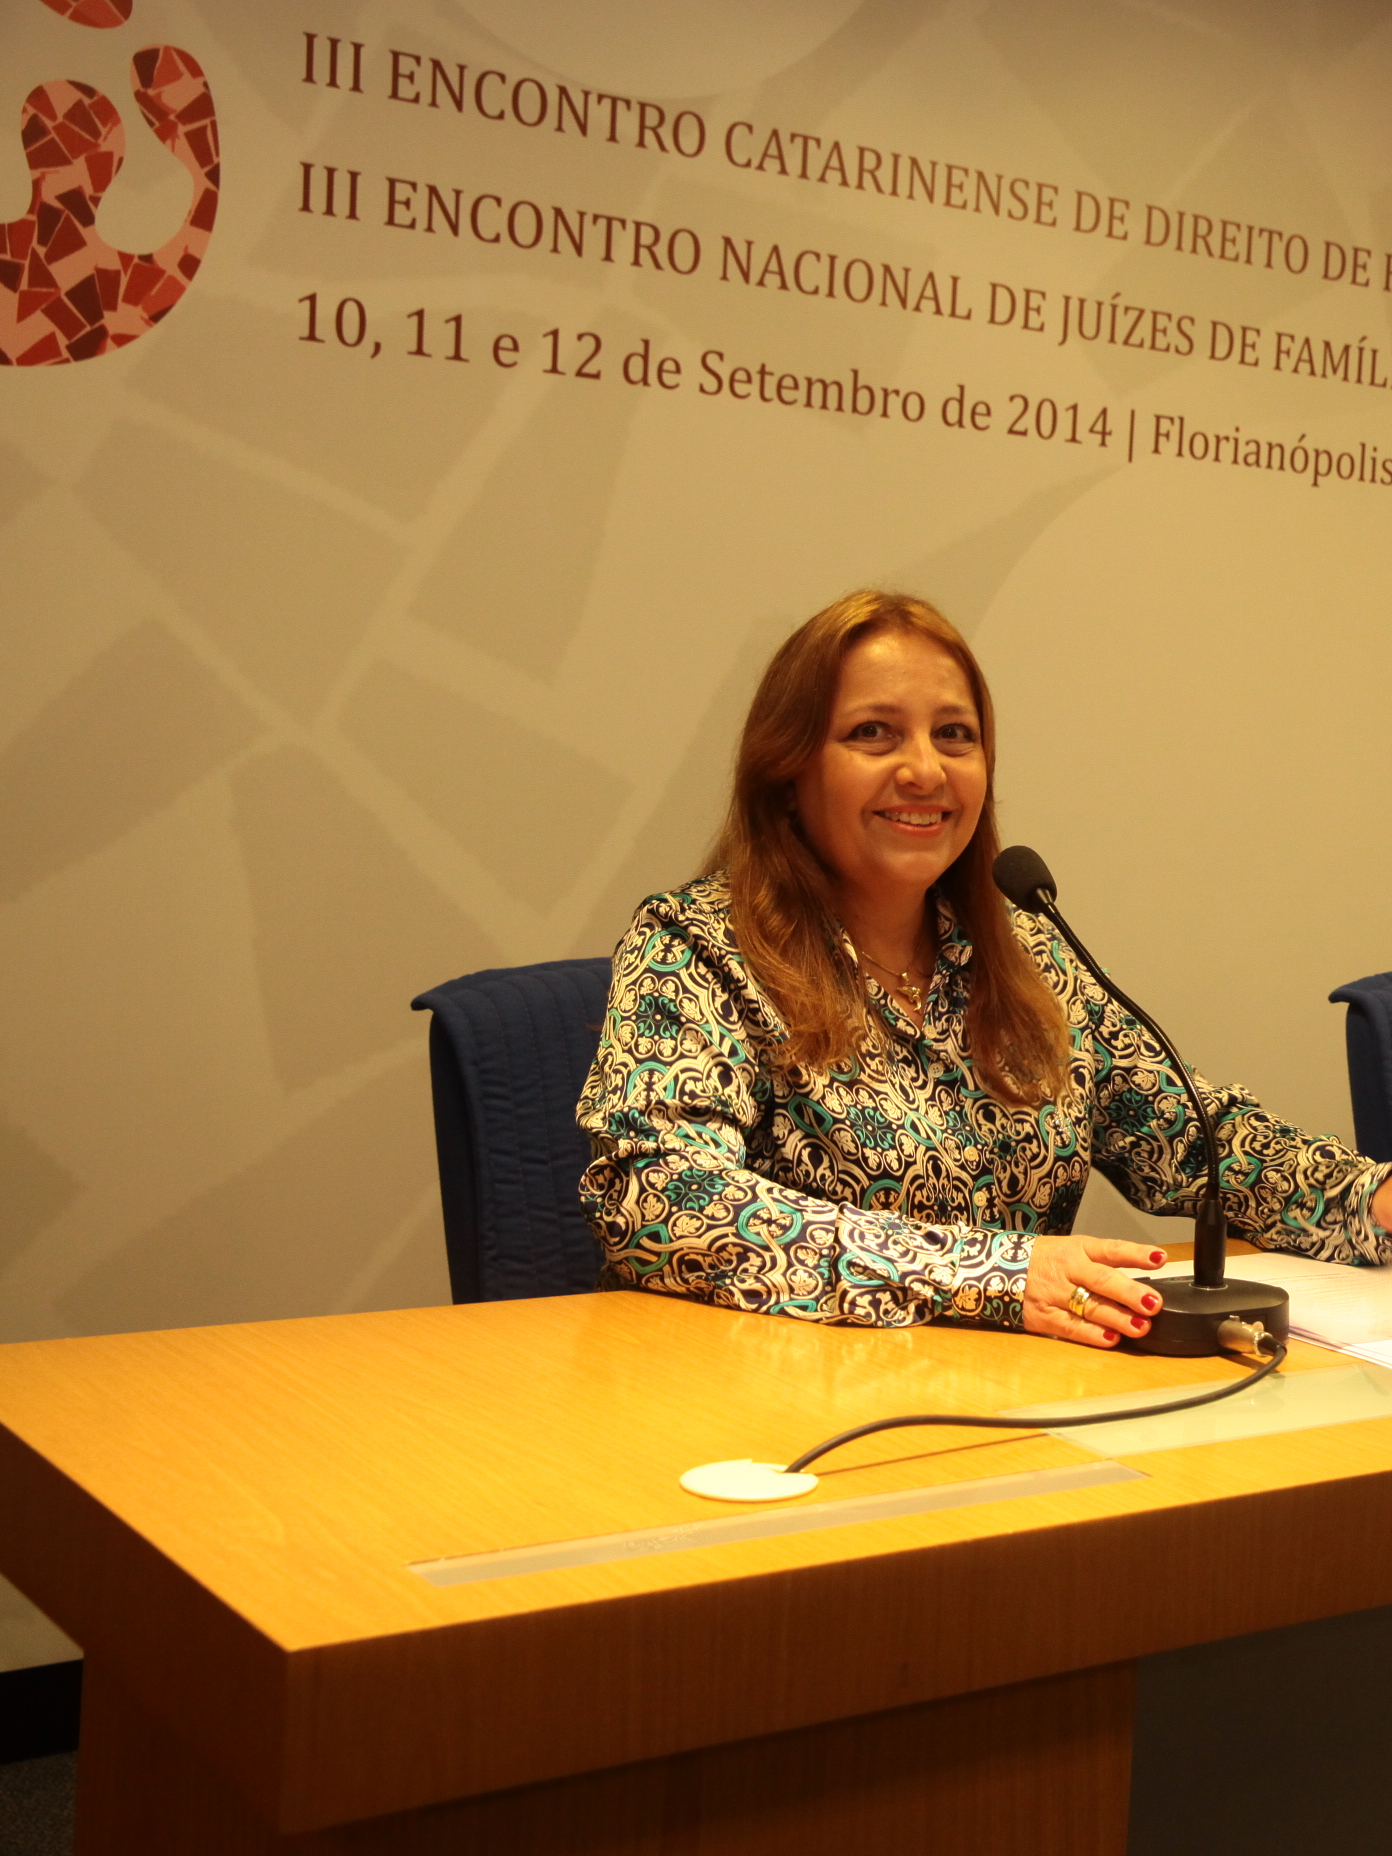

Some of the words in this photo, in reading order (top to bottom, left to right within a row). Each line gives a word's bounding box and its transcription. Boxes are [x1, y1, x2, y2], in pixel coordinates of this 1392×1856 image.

[302, 31, 365, 94] III
[387, 48, 707, 158] ENCONTRO
[723, 120, 1059, 229] CATARINENSE
[1072, 189, 1130, 242] DE
[1142, 203, 1310, 275] DIREITO
[1321, 239, 1373, 288] DE
[298, 161, 363, 222] III
[383, 175, 702, 276] ENCONTRO
[718, 235, 973, 321] NACIONAL
[986, 281, 1047, 333] DE
[1056, 291, 1197, 357] JUÍZES
[1207, 319, 1262, 369] DE
[297, 291, 383, 361] 10,
[405, 308, 471, 365] 11
[491, 330, 521, 370] e
[540, 327, 603, 381] 12
[620, 338, 683, 391] de
[697, 348, 926, 423] Setembro
[939, 383, 994, 433] de
[1005, 392, 1114, 449] 2014
